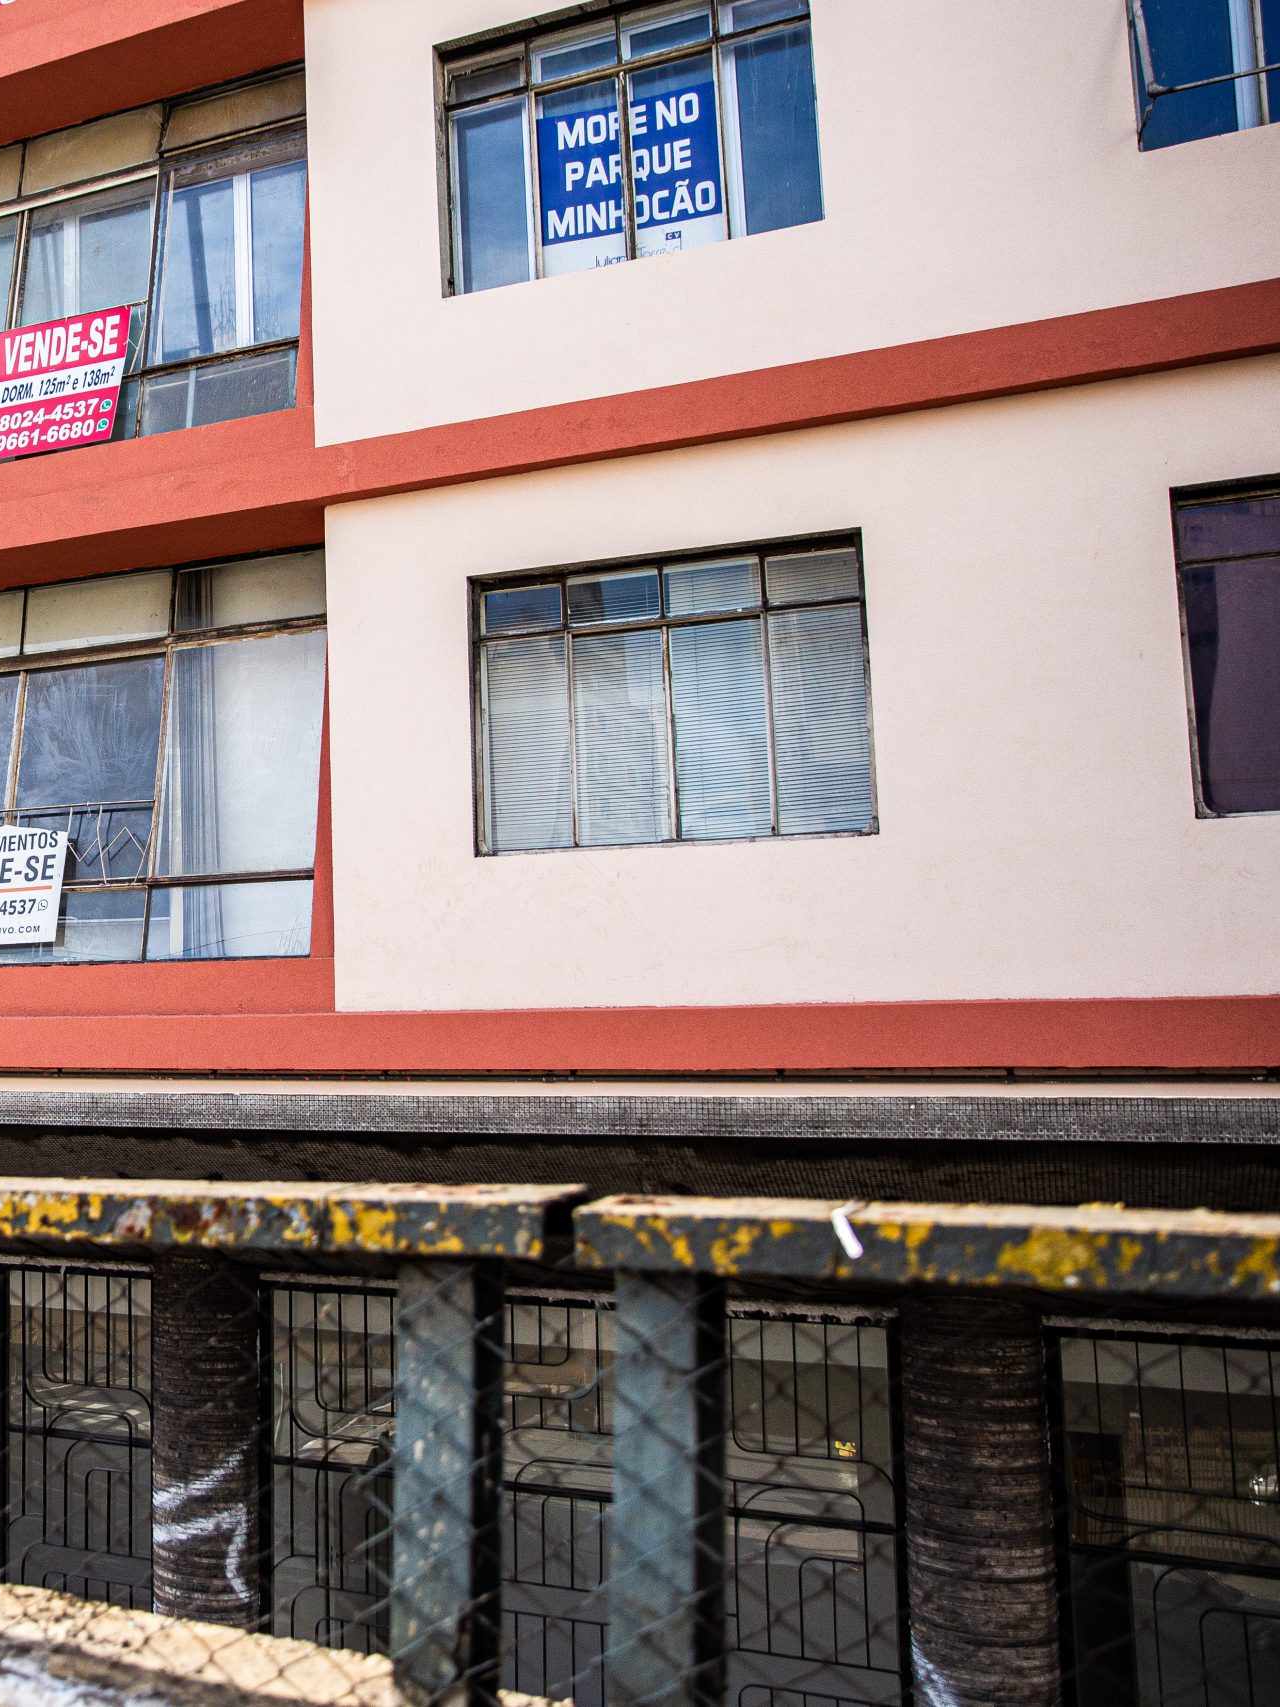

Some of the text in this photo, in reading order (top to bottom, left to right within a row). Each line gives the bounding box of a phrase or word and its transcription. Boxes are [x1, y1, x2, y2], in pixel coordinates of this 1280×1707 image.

[655, 92, 700, 131] NO
[4, 314, 121, 376] VENDE-SE
[1, 382, 34, 404] DORM.
[72, 379, 78, 390] e
